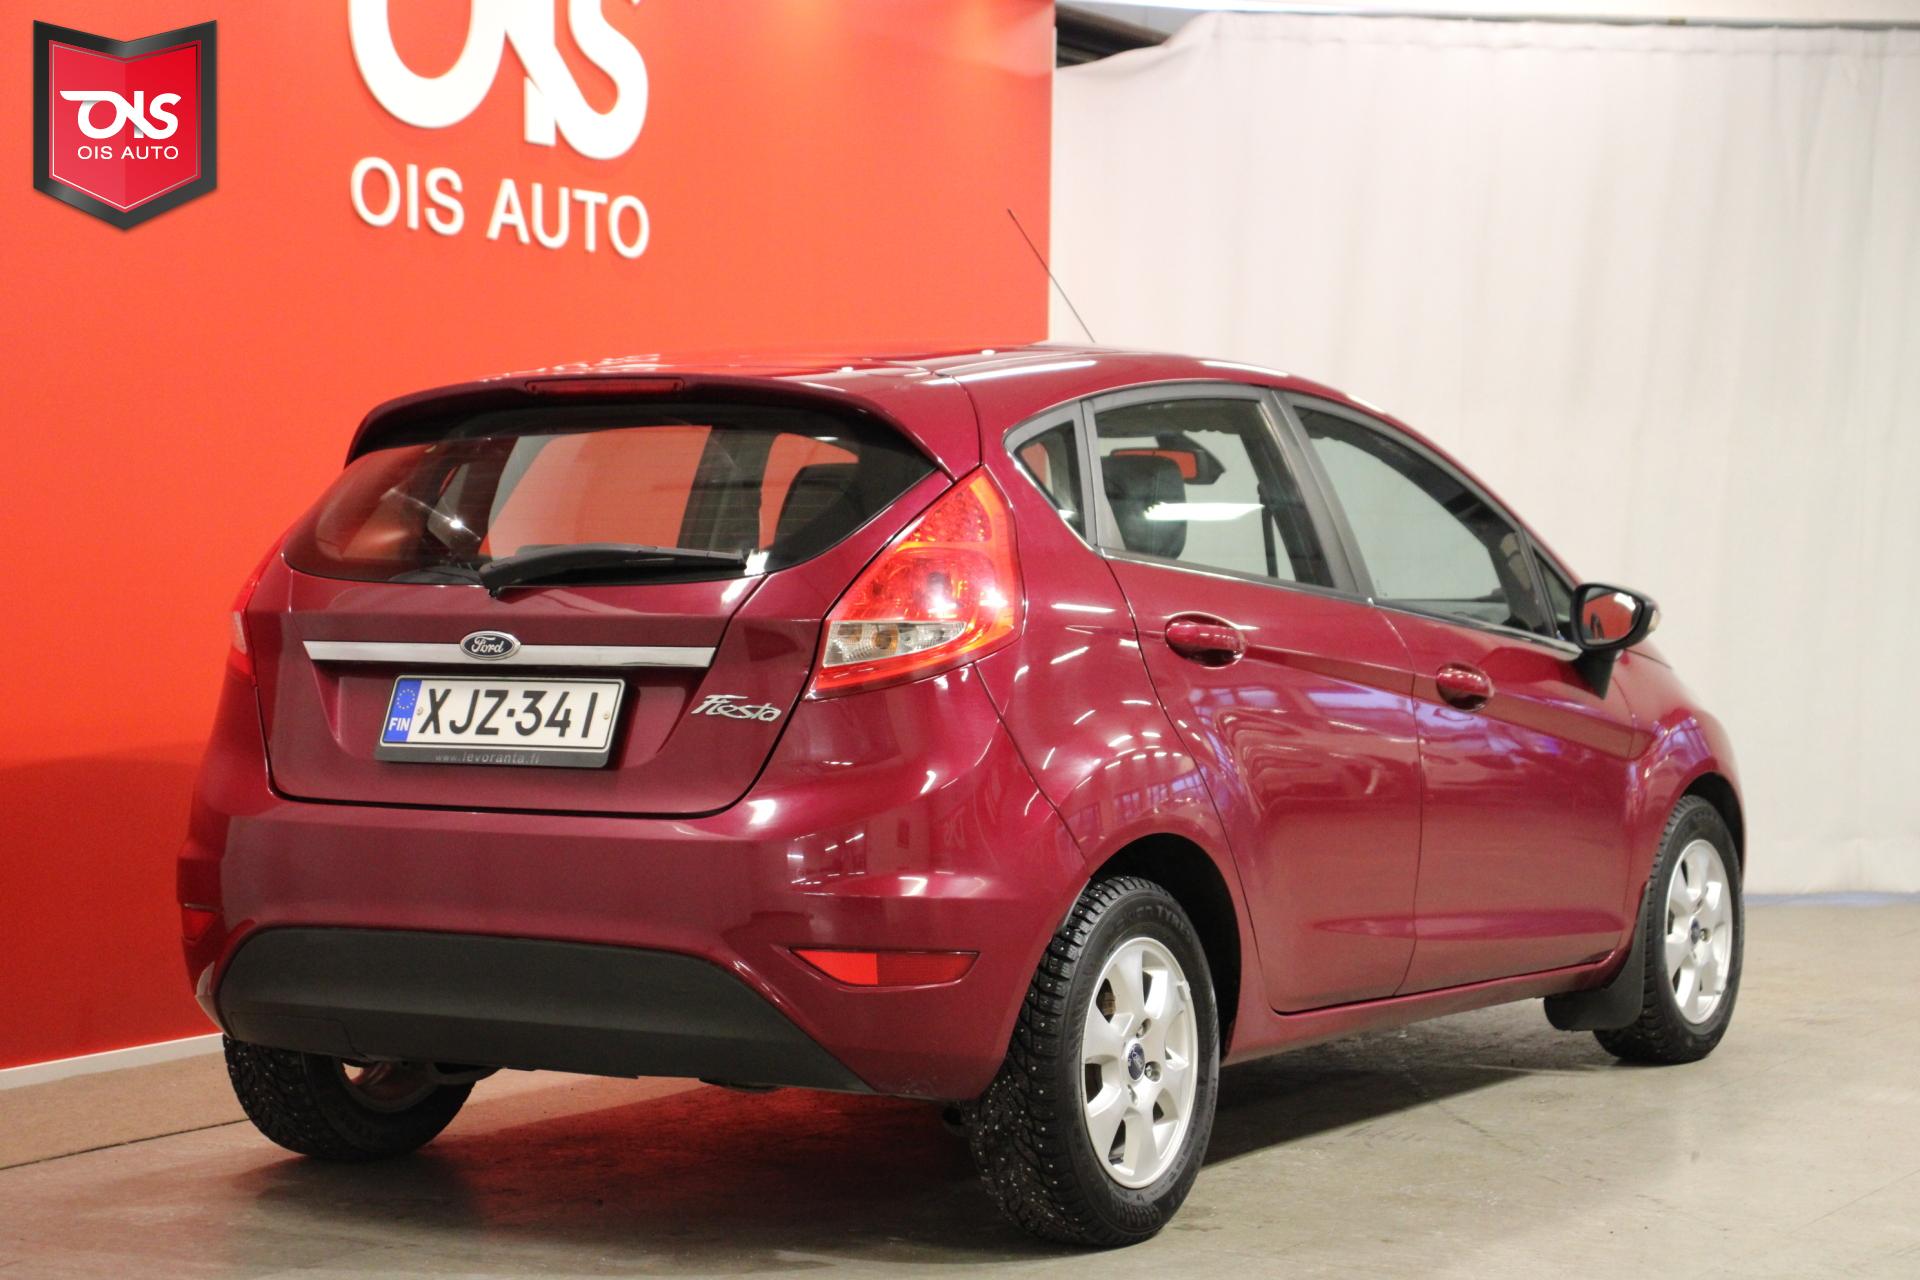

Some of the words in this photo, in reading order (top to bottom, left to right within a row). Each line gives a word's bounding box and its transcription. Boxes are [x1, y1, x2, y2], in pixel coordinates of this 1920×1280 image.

[350, 156, 465, 236] OIS
[486, 178, 650, 259] AUTO
[471, 636, 505, 653] Ford
[691, 694, 782, 722] Fiesta
[388, 717, 411, 732] FIN
